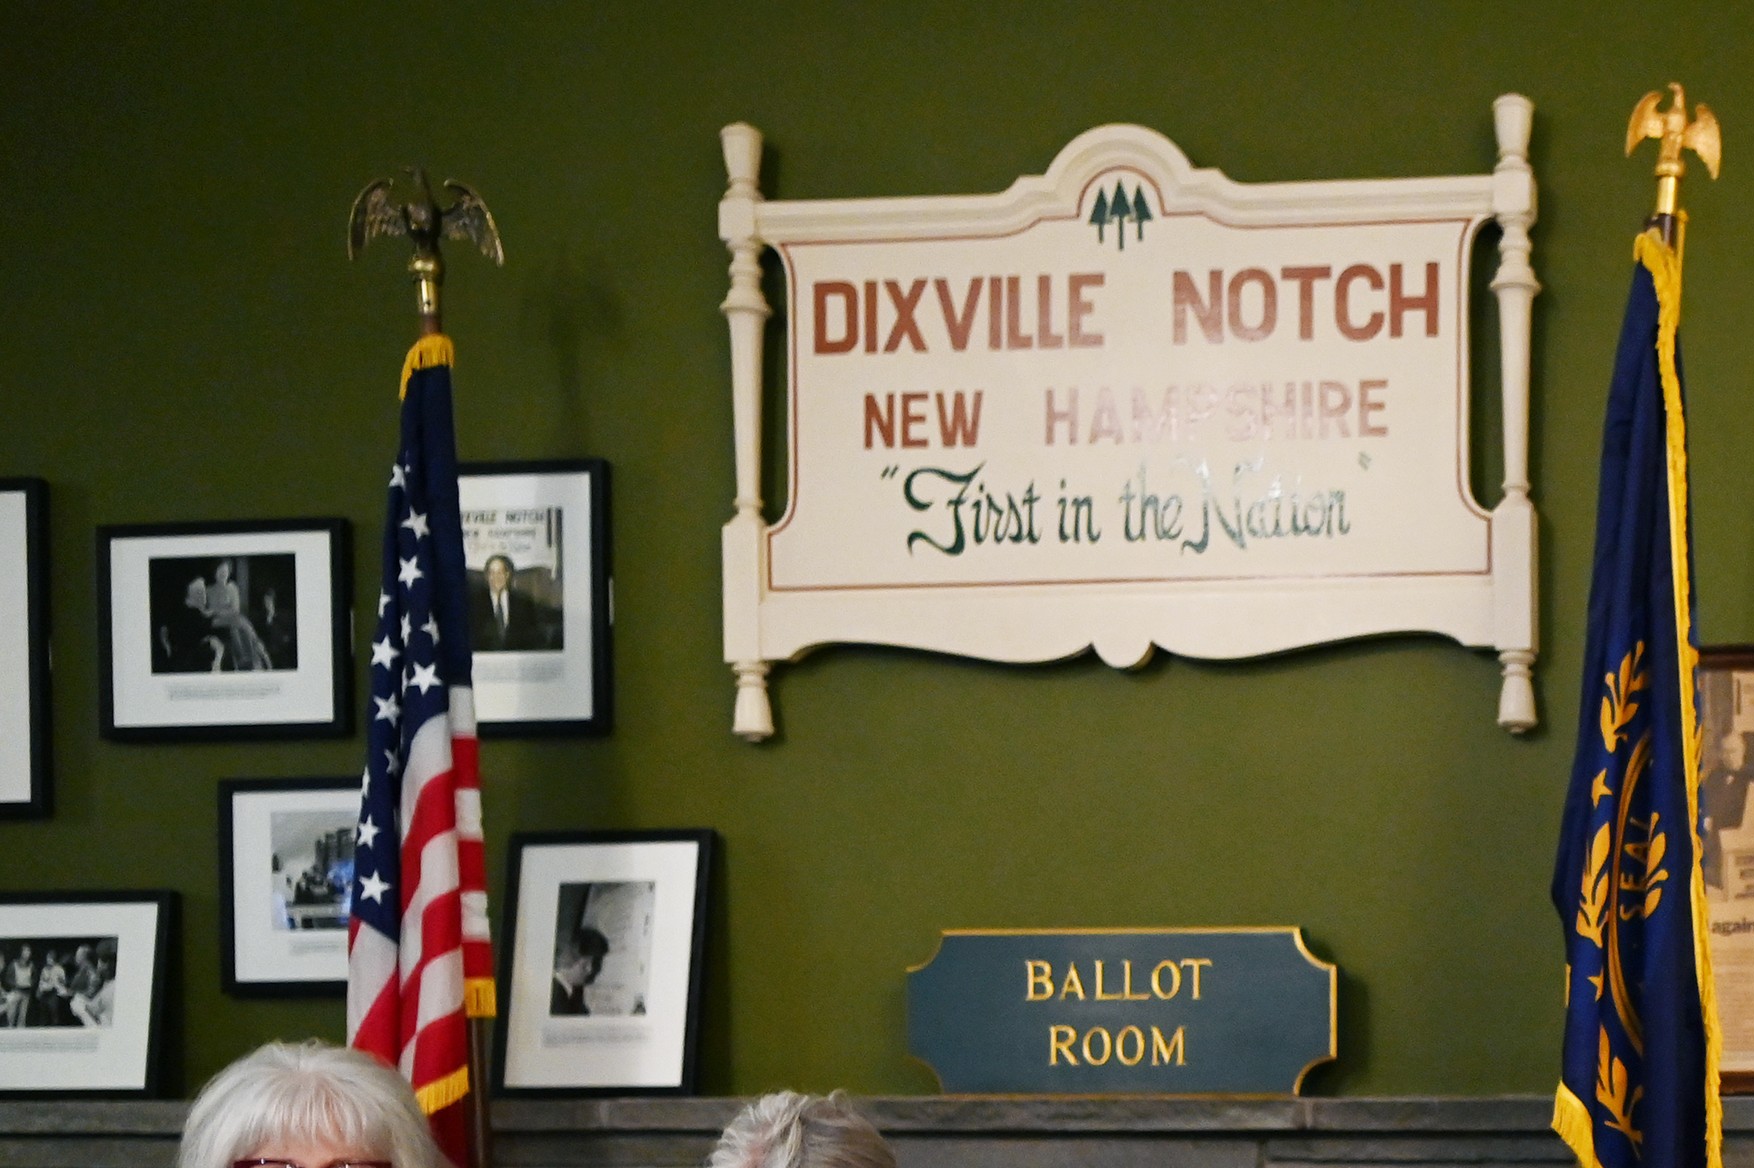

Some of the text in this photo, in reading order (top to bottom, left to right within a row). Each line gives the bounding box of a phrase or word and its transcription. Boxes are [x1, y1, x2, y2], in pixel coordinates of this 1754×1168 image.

[812, 261, 1441, 356] DIXVILLE NOTCH
[863, 379, 1389, 450] NEW HAMPSHIRE
[1057, 477, 1102, 544] in
[1118, 461, 1184, 542] the
[1025, 957, 1213, 1002] BALLOT
[1049, 1024, 1187, 1067] ROOM
